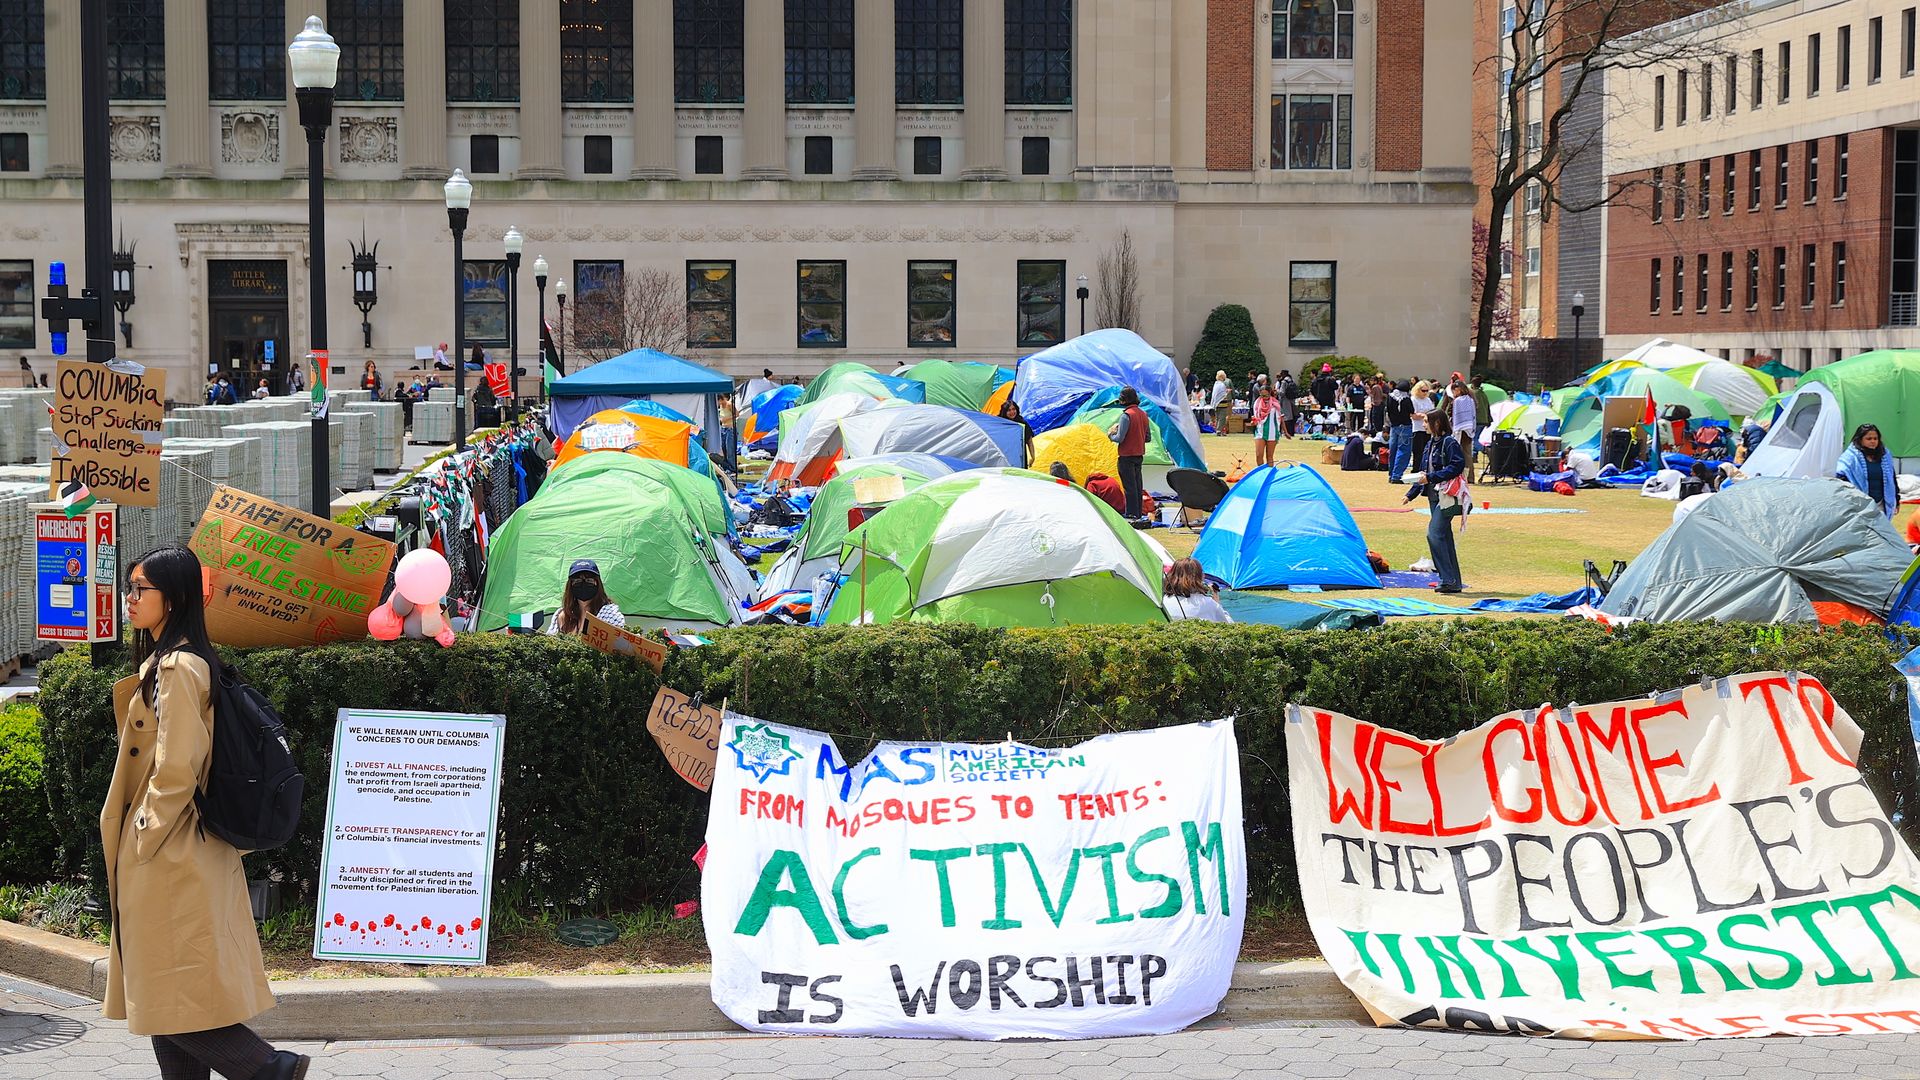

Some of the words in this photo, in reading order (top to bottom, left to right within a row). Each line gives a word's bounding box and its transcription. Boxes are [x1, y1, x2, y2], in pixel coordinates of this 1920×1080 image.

[232, 271, 265, 279] BUTLER
[232, 279, 266, 288] LIBRARY
[38, 519, 84, 539] EMERGENCY
[215, 494, 284, 527] STAFF
[283, 517, 332, 546] FOR
[334, 537, 355, 555] A
[230, 524, 303, 564] FREE
[224, 552, 370, 614] PALESTINE
[232, 584, 265, 601] WANT
[268, 595, 283, 606] TO
[285, 602, 308, 614] GET
[238, 599, 299, 624] INVOLVED?
[357, 735, 401, 743] CONCEDES
[437, 739, 480, 747] DEMANDS:
[385, 728, 417, 736] REMAIN
[446, 731, 489, 739] COLUMBIA
[950, 745, 1047, 761] MUSLIM
[1314, 702, 1721, 837] WELCOME
[1738, 677, 1857, 785] TO
[404, 764, 448, 772] FINANCES,
[450, 765, 486, 774] including
[950, 755, 1086, 772] AMERICAN
[360, 770, 409, 778] endowment,
[433, 773, 486, 782] corporations
[816, 742, 936, 803] MAS
[950, 768, 1049, 783] SOCIETY
[357, 787, 396, 795] genocide,
[416, 789, 460, 797] occupation
[366, 778, 389, 786] profit
[413, 780, 438, 788] Israeli
[440, 781, 482, 790] apartheid,
[740, 788, 805, 828] FROM
[826, 795, 977, 839] MOSQUES
[991, 794, 1034, 820] TO
[1057, 780, 1168, 821] TENTS:
[344, 826, 388, 834] COMPLETE
[392, 828, 458, 837] TRANSPARENCY
[347, 834, 391, 842] Columbia's
[430, 838, 482, 846] investments.
[1322, 833, 1446, 896] THE
[1445, 777, 1897, 935] PEOPLE'S
[339, 875, 367, 883] faculty
[370, 876, 413, 885] disciplined
[419, 869, 455, 877] students
[331, 883, 374, 891] movement
[391, 885, 435, 893] Palestinian
[438, 887, 479, 895] liberation.
[734, 820, 1230, 945] ACTIVISM
[1338, 884, 1920, 1000] UNIVERSIT
[758, 971, 843, 1024] IS
[890, 954, 1167, 1018] WORSHIP
